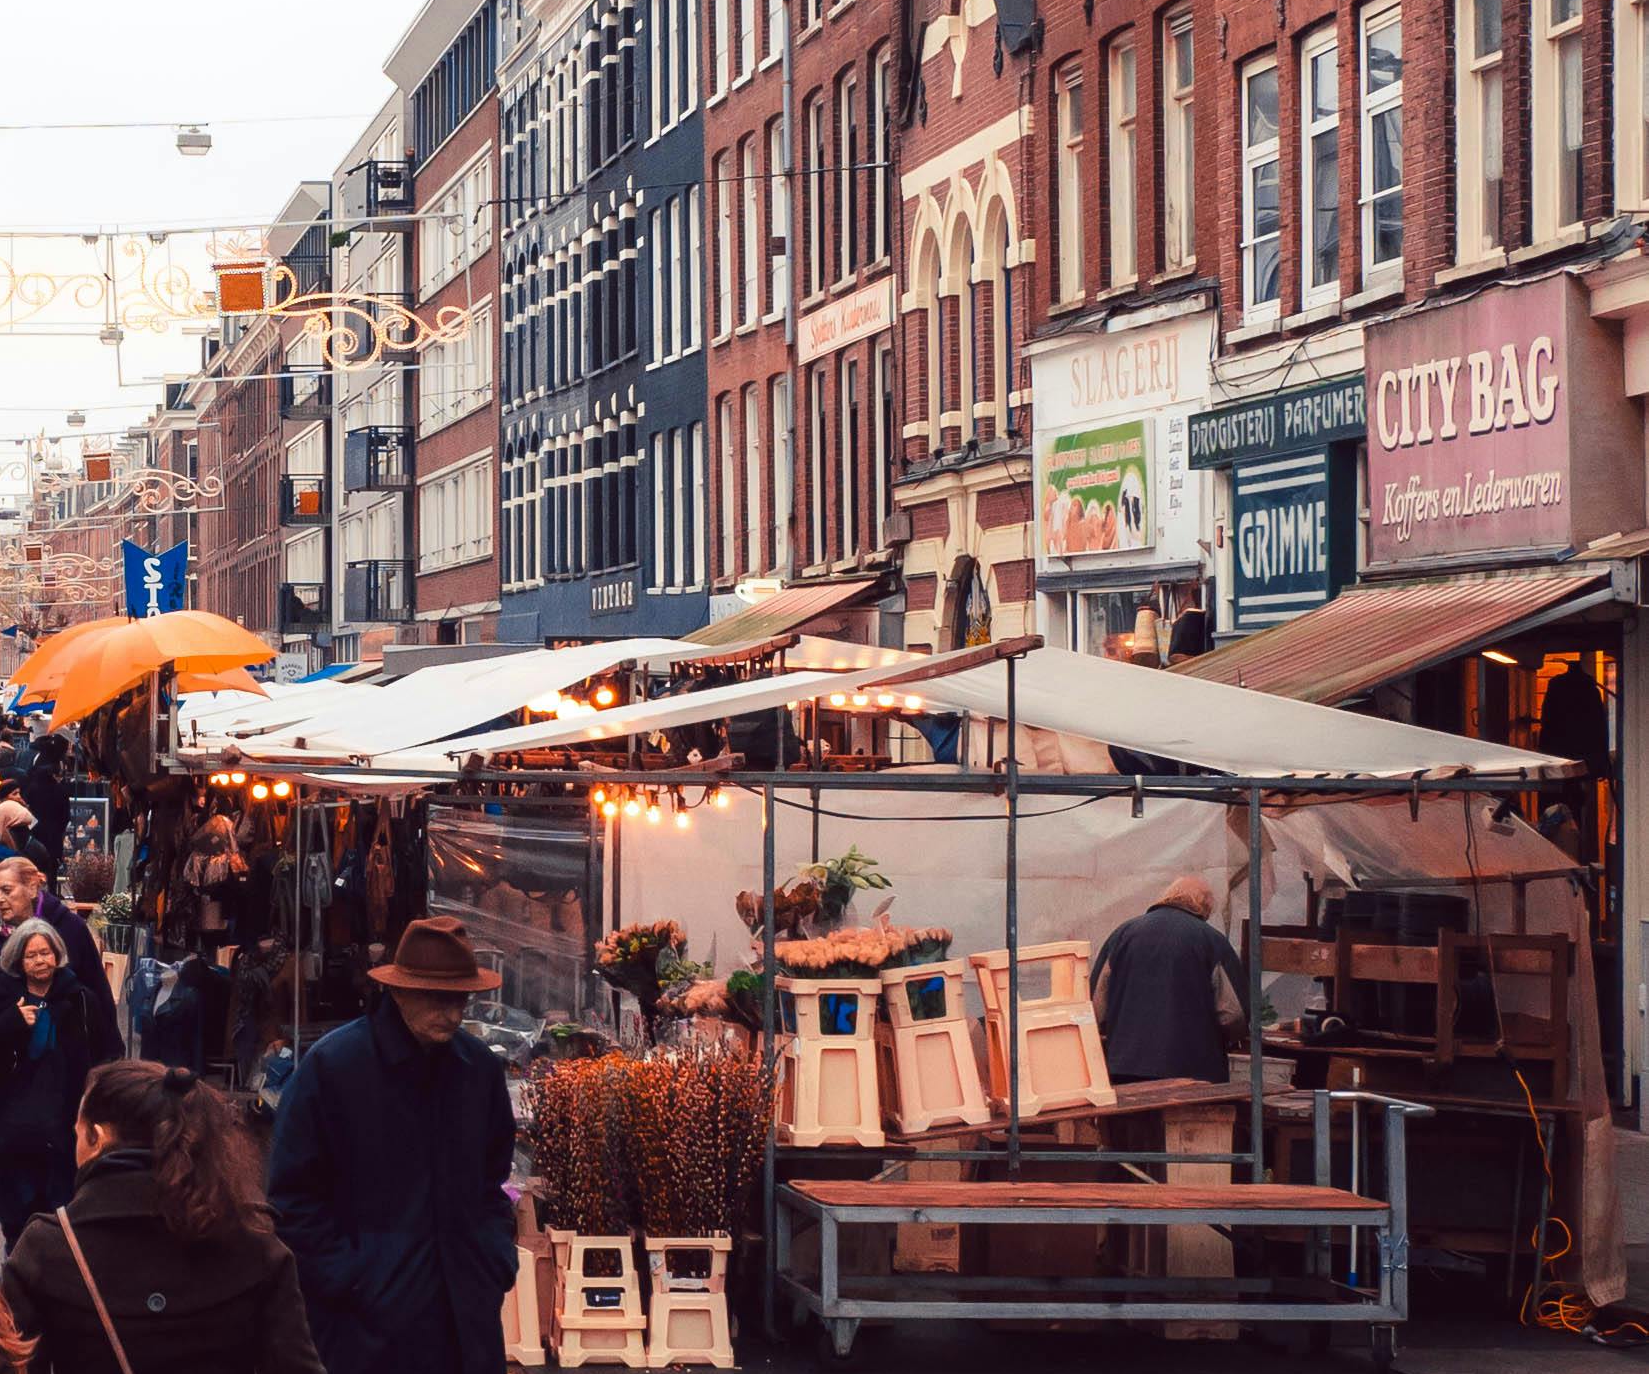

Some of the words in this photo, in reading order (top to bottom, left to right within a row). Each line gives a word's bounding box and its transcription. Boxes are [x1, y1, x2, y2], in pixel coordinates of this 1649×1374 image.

[1070, 333, 1180, 408] SLAGERIJ
[1376, 357, 1461, 451] CITY
[1467, 336, 1559, 436] BAG
[1191, 405, 1275, 457] DROGISTERIJ
[1238, 501, 1326, 585] GRIMME
[1382, 475, 1440, 543] Koffers
[1442, 486, 1461, 518] en
[1462, 469, 1562, 518] Lederwaren
